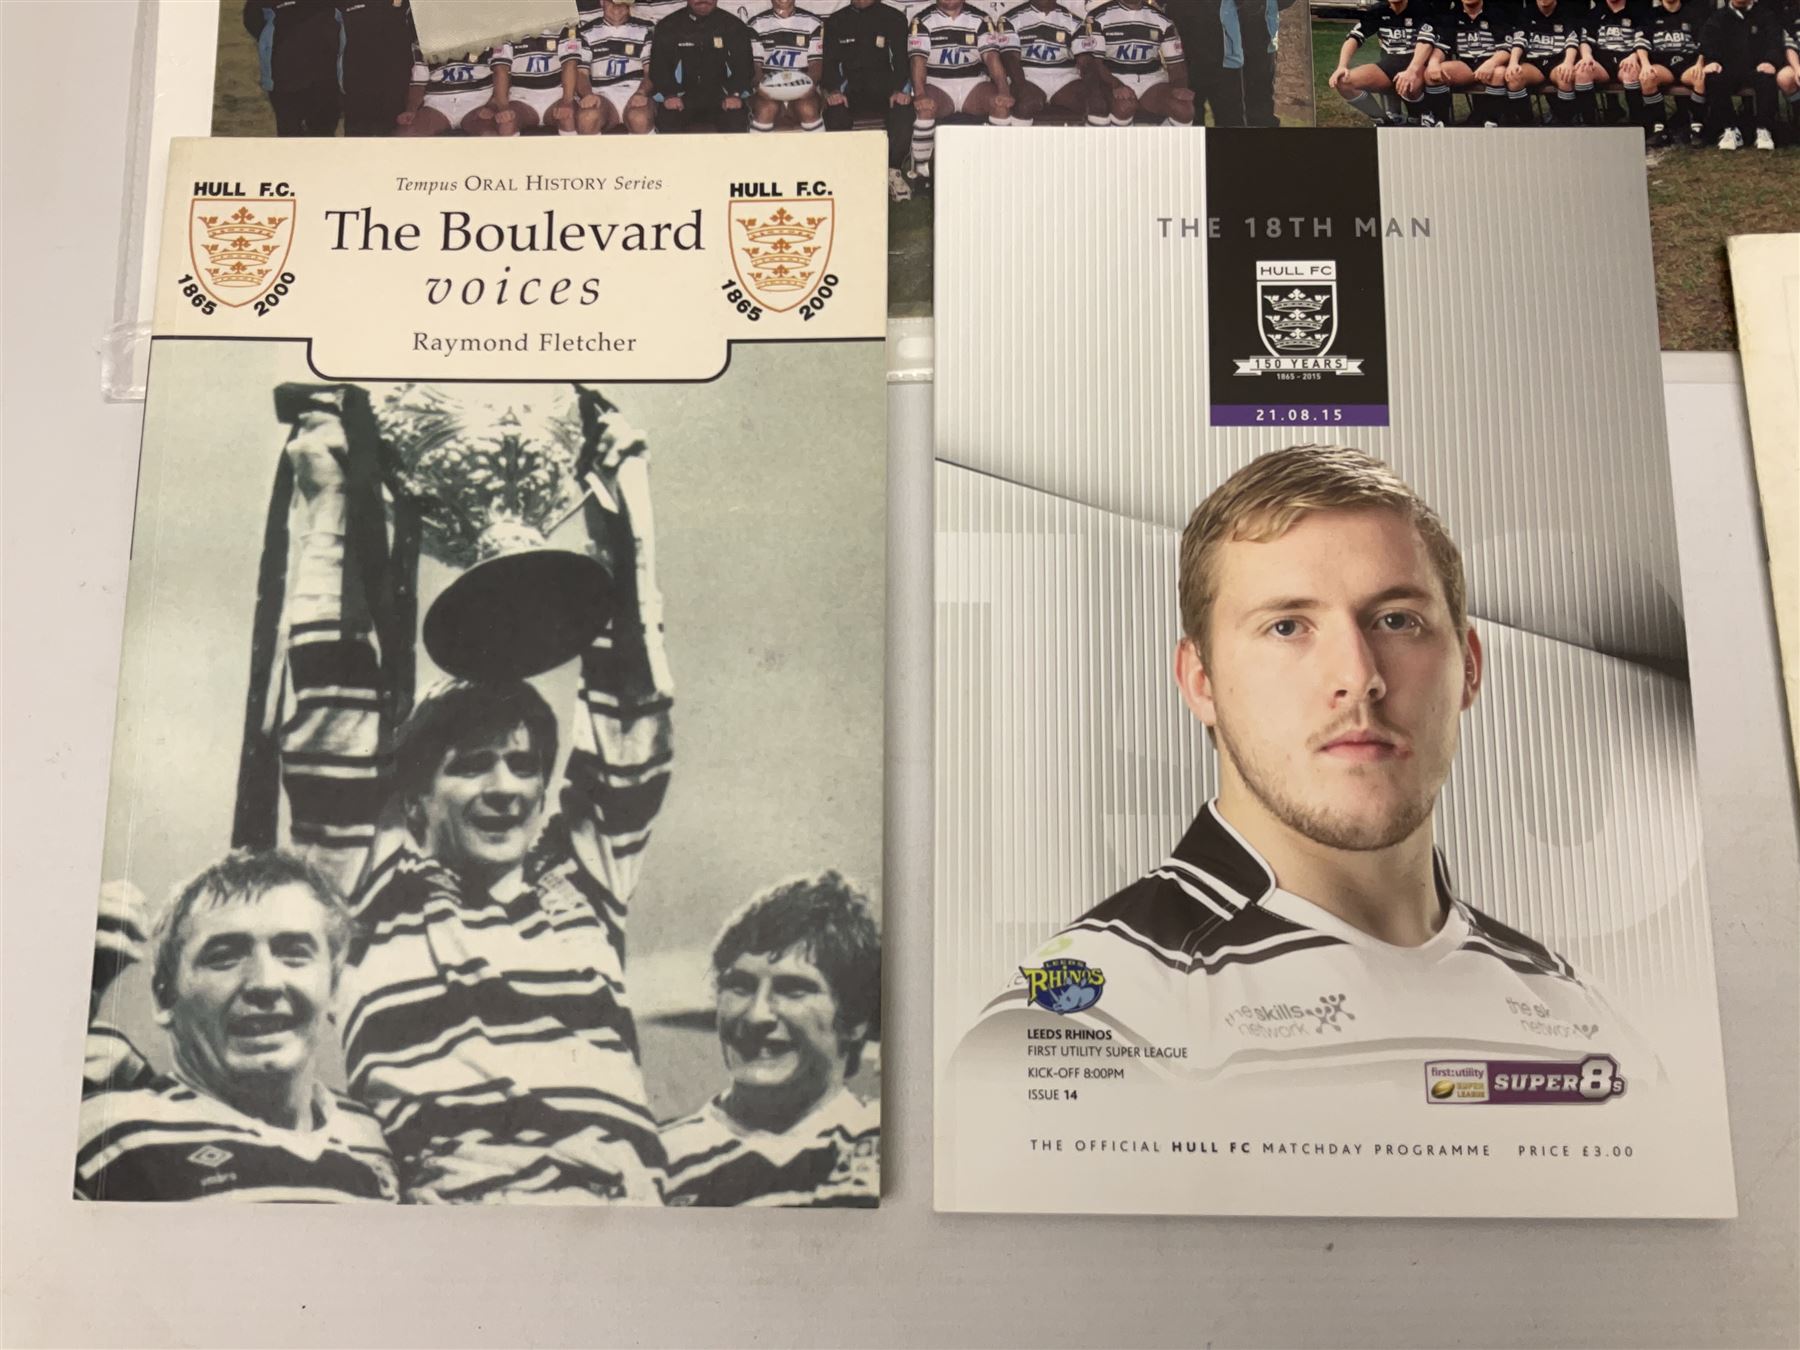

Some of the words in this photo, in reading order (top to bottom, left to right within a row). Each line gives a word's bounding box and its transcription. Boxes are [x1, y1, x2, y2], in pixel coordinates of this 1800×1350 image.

[194, 182, 246, 197] HULL
[259, 182, 296, 197] F.C.
[396, 177, 458, 195] Tempus
[464, 175, 518, 191] ORAL
[526, 174, 607, 191] HISTORY
[614, 175, 663, 191] Series
[730, 182, 783, 198] HULL
[796, 181, 834, 197] F.C.
[325, 207, 421, 252] The
[440, 208, 706, 252] Boulevard
[1157, 217, 1221, 238] THE
[1244, 217, 1333, 238] 18TH
[1355, 217, 1431, 238] MAN
[1260, 266, 1304, 276] HULL
[1310, 266, 1333, 276] FC
[177, 273, 218, 317] 1865
[253, 271, 296, 317] 2000
[426, 265, 601, 306] voices
[721, 278, 764, 322] 1865
[798, 273, 840, 322] 2000
[412, 331, 529, 357] Raymond
[539, 331, 637, 352] Fletcher
[1255, 359, 1282, 369] 150
[1291, 359, 1343, 369] YEARS
[1276, 373, 1296, 381] 1865
[1256, 409, 1343, 421] 21.08.15
[1027, 1029, 1062, 1039] LEEDS
[1065, 1029, 1112, 1040] RHINOS
[1027, 1046, 1056, 1057] FIRST
[1060, 1046, 1102, 1057] UTILITY
[1106, 1047, 1141, 1058] SUPER
[1144, 1047, 1188, 1058] LEAGUE
[1028, 1067, 1080, 1078] KICK-OFF
[1083, 1067, 1125, 1079] 8:00PM
[1494, 1073, 1579, 1092] SUPER
[1028, 1089, 1060, 1101] ISSUE
[1063, 1089, 1078, 1101] 14
[1030, 1139, 1063, 1151] THE
[1075, 1140, 1161, 1152] OFFICIAL
[1171, 1141, 1219, 1153] HULL
[1229, 1142, 1251, 1153] FC
[1262, 1142, 1363, 1155] MATCHDAY
[1374, 1144, 1490, 1156] PROGRAMME
[1518, 1145, 1570, 1157] PRICE
[1582, 1145, 1634, 1158] £3.00
